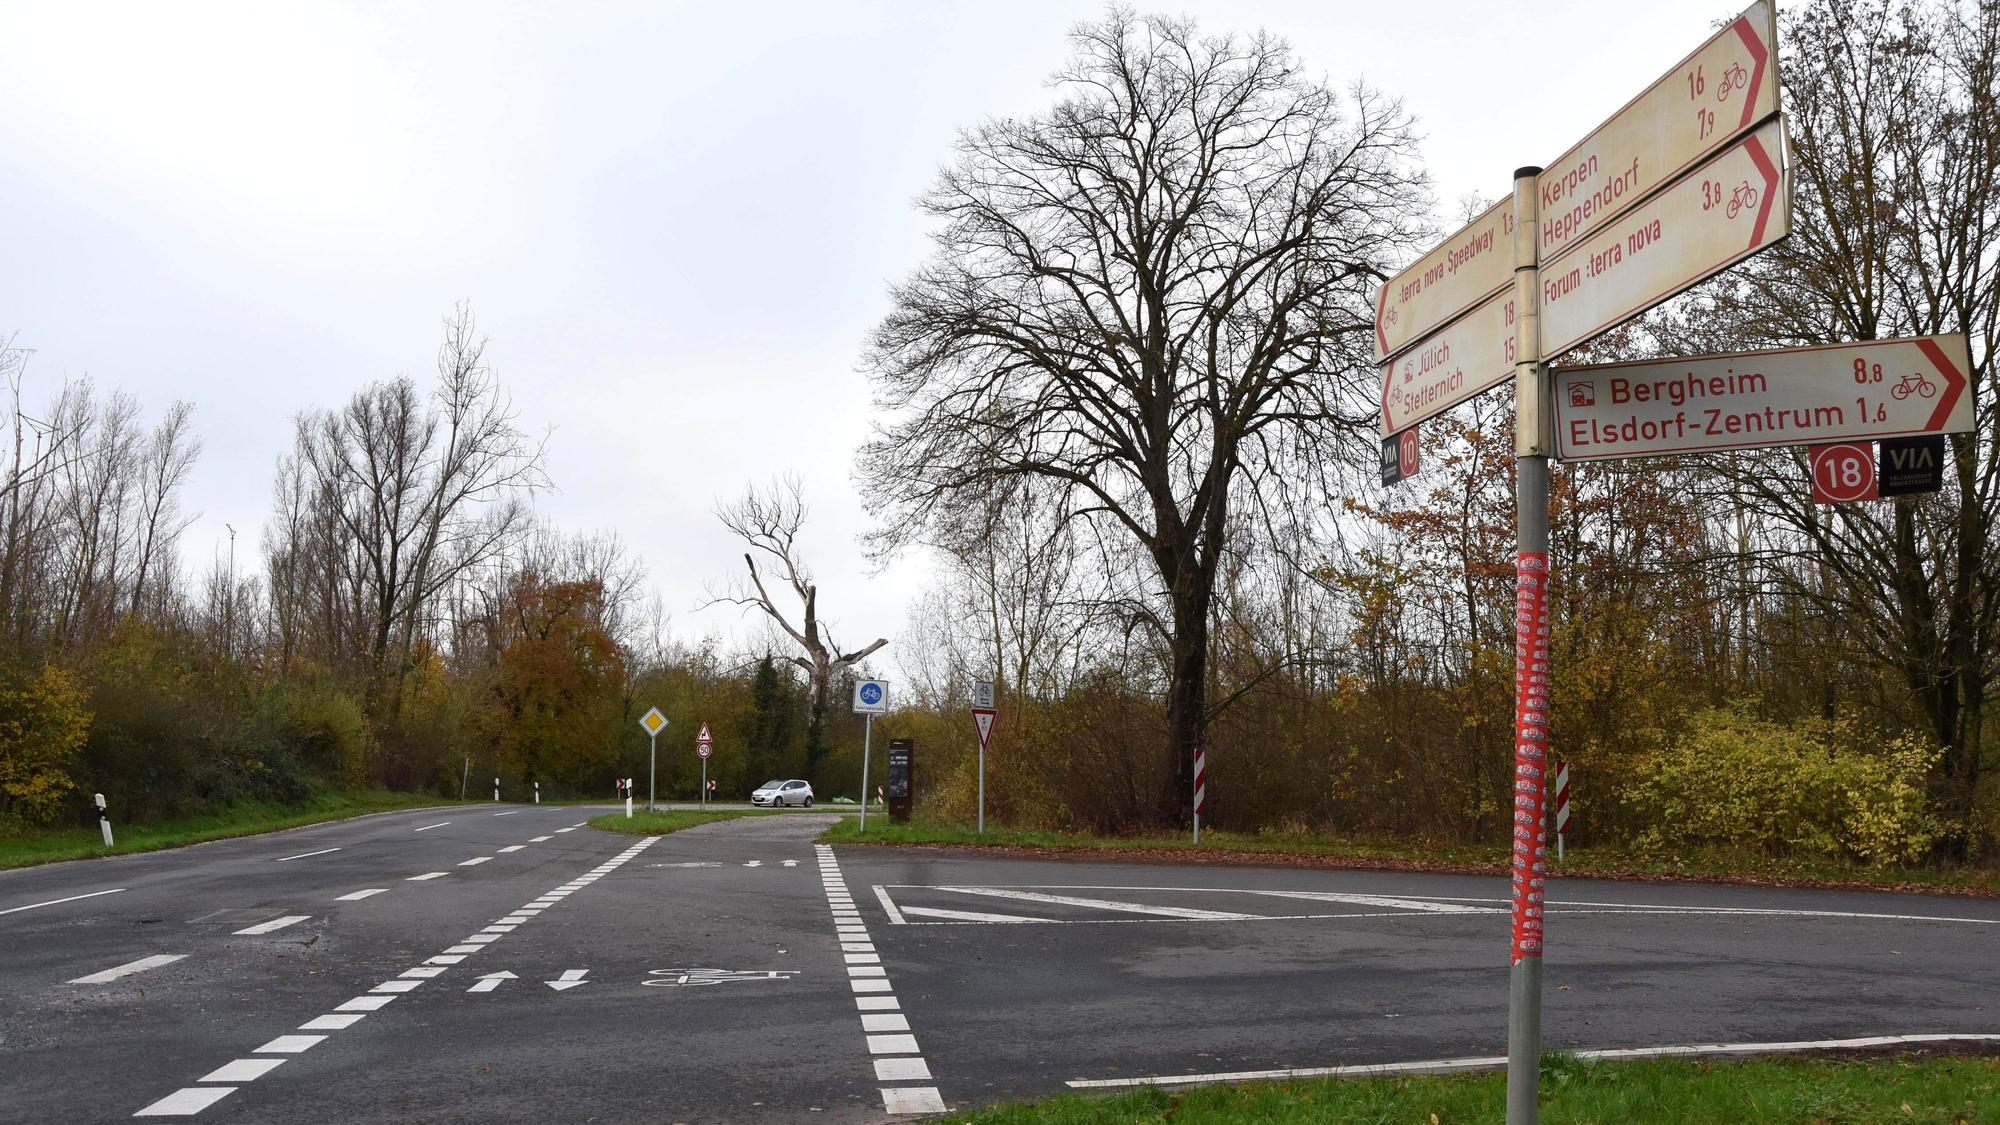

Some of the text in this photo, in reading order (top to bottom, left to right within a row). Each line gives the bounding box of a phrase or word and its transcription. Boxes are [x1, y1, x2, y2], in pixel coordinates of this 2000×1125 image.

[1688, 65, 1705, 100] 16
[1542, 154, 1598, 210] Kerpen
[1543, 157, 1639, 248] Heppendorf
[1424, 263, 1444, 292] nova
[1447, 227, 1494, 273] Speedway
[1544, 265, 1580, 305] Forum
[1628, 218, 1661, 256] nova
[1504, 300, 1515, 328] 18
[1418, 344, 1450, 376] Jülich
[1503, 336, 1515, 364] 15
[1404, 367, 1463, 415] Stetternich
[1611, 369, 1768, 407] Bergheim
[1570, 404, 1844, 446] Elsdorf-Zentrum
[1403, 440, 1415, 466] 10
[1825, 457, 1861, 489] 18
[700, 746, 709, 754] 50
